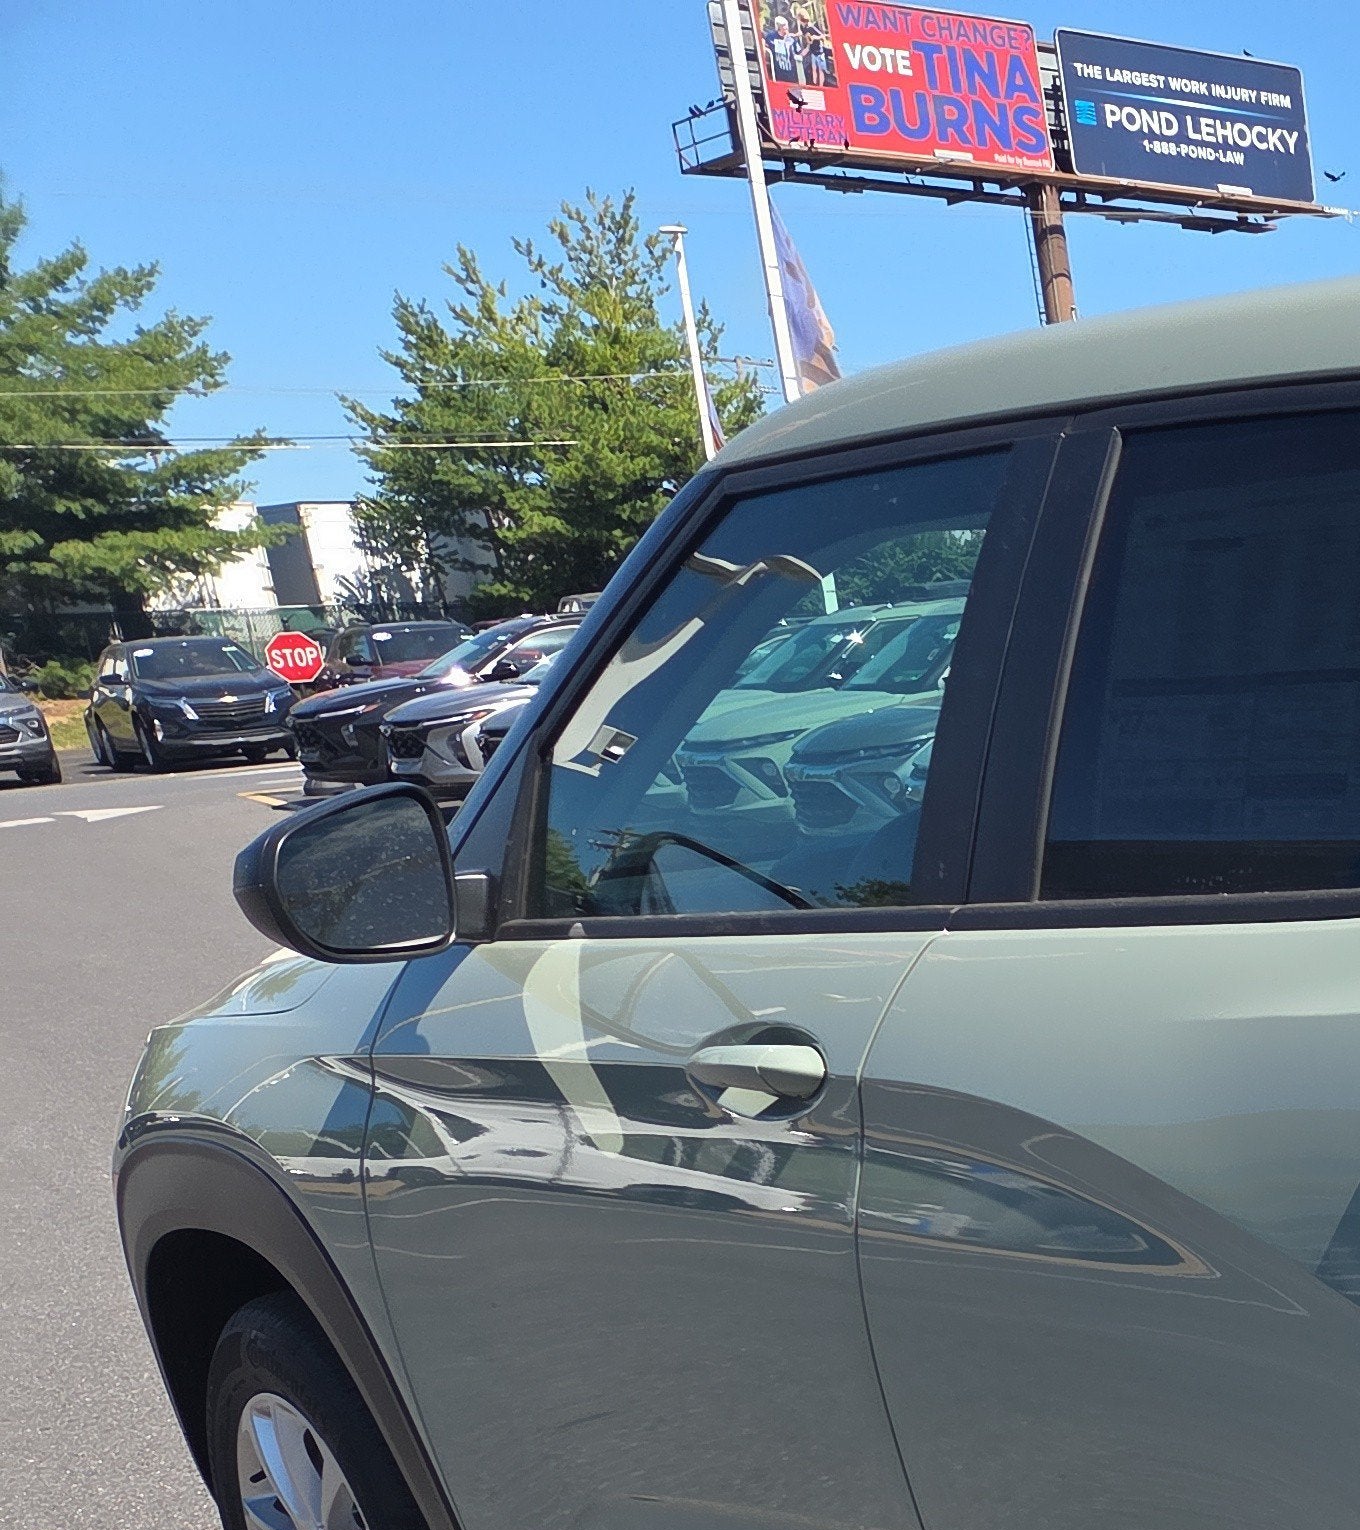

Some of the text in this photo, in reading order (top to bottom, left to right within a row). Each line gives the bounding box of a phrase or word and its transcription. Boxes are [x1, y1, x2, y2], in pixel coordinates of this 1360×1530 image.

[835, 3, 1032, 50] WANT CHANGE?
[843, 40, 1041, 103] VOTE TINA
[1073, 62, 1292, 109] THE LARGEST WORK INJURY FIRM
[772, 108, 845, 127] MILITARY
[775, 125, 849, 145] VETERAN
[848, 83, 1049, 155] BURNS
[1104, 102, 1299, 155] POND LEHOCKY
[271, 646, 318, 669] STOP
